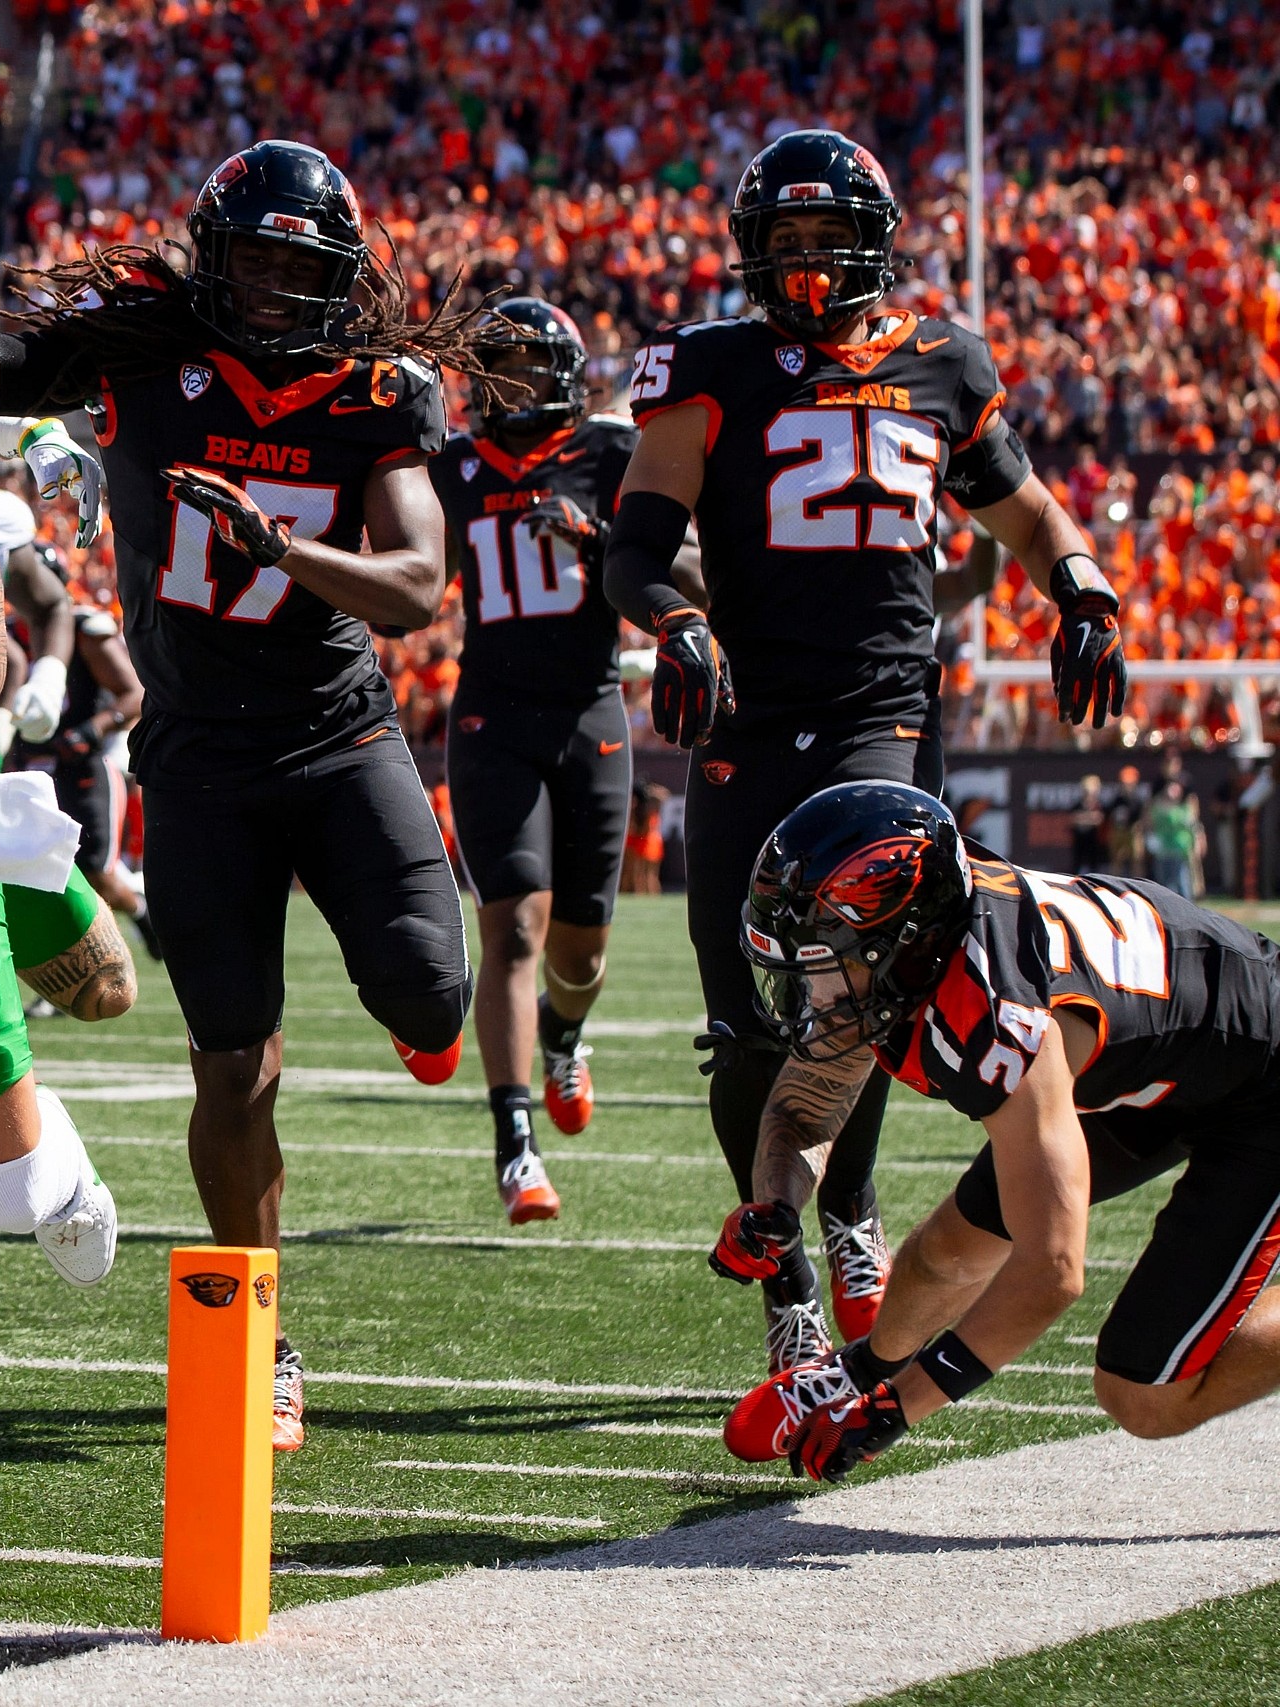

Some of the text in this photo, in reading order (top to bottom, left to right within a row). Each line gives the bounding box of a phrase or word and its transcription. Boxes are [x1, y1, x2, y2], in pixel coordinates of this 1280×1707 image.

[186, 379, 201, 393] 12
[371, 361, 397, 407] C
[630, 344, 675, 401] 25
[816, 383, 911, 411] BEAVS
[205, 435, 310, 474] BEAVS
[764, 406, 940, 552] 25
[156, 462, 340, 624] 17
[468, 515, 585, 624] 10
